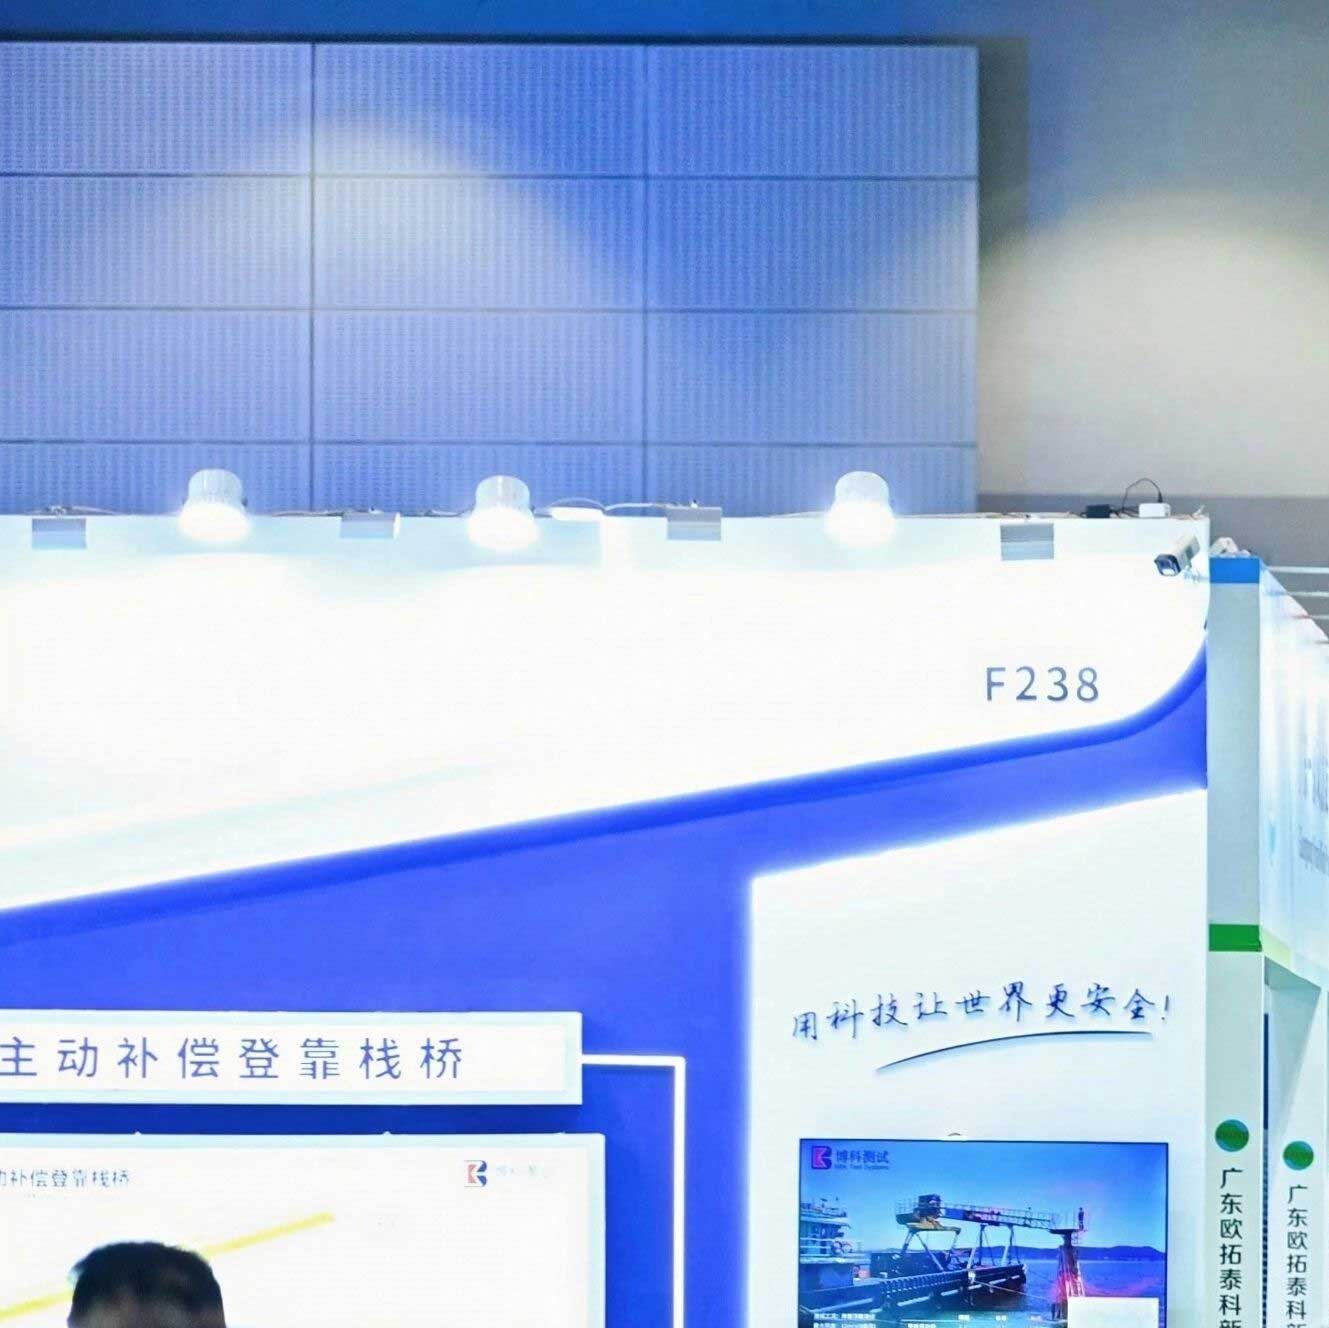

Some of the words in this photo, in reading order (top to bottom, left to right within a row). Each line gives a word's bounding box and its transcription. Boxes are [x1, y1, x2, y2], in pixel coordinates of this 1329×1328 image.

[986, 666, 1099, 701] F238
[0, 1036, 463, 1080] 主动补偿登靠栈桥
